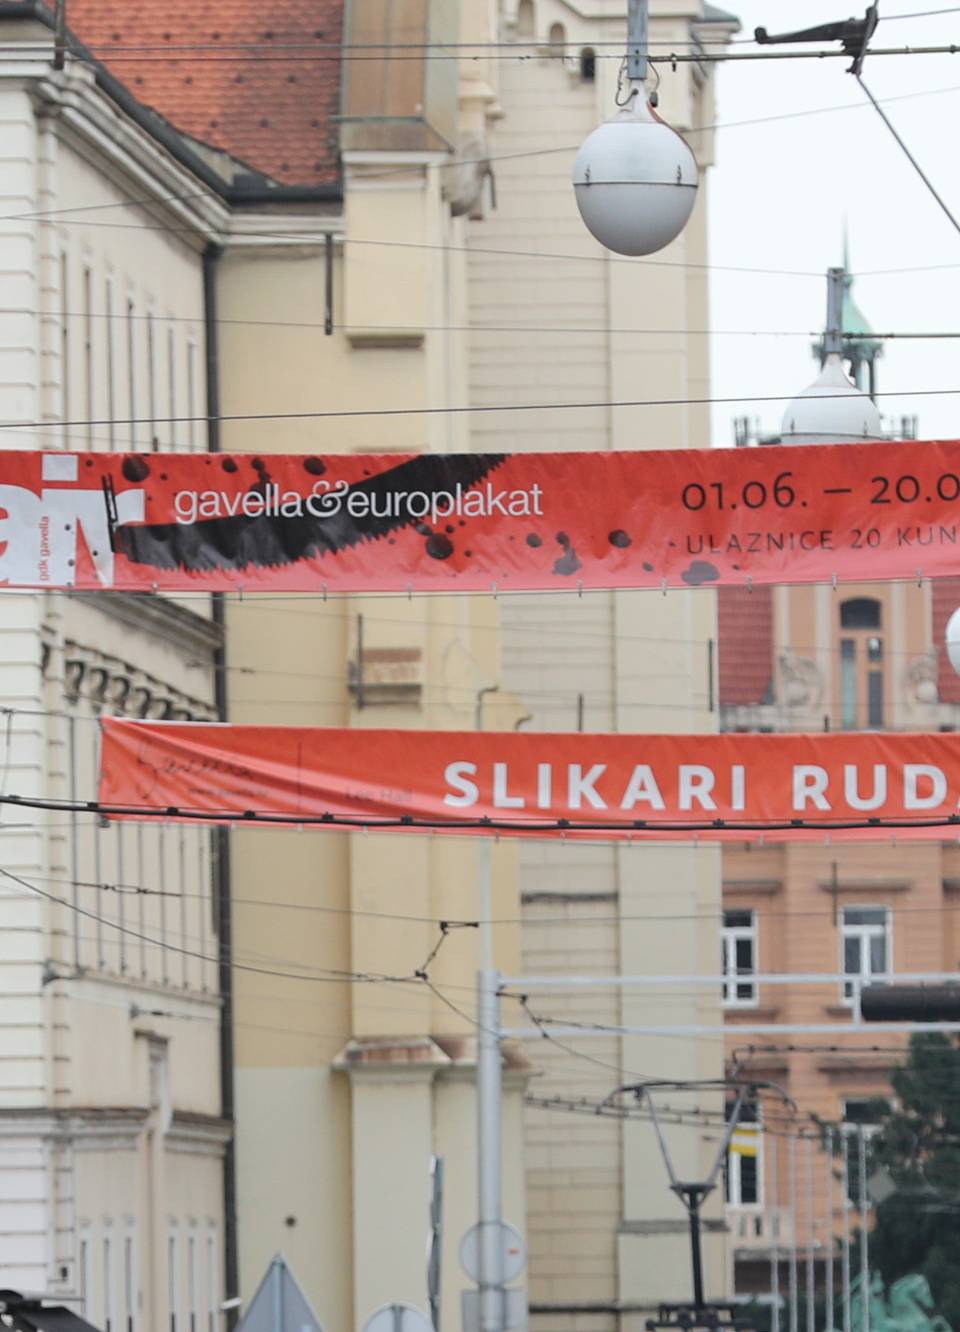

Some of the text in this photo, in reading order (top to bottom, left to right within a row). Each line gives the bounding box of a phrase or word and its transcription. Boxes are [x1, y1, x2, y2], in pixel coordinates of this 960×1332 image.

[175, 480, 544, 525] gavella&europlakat
[681, 471, 808, 511] 01.06.
[686, 525, 957, 554] ULAZNICE 20 KUN
[443, 761, 960, 811] SLIKARI RUD
